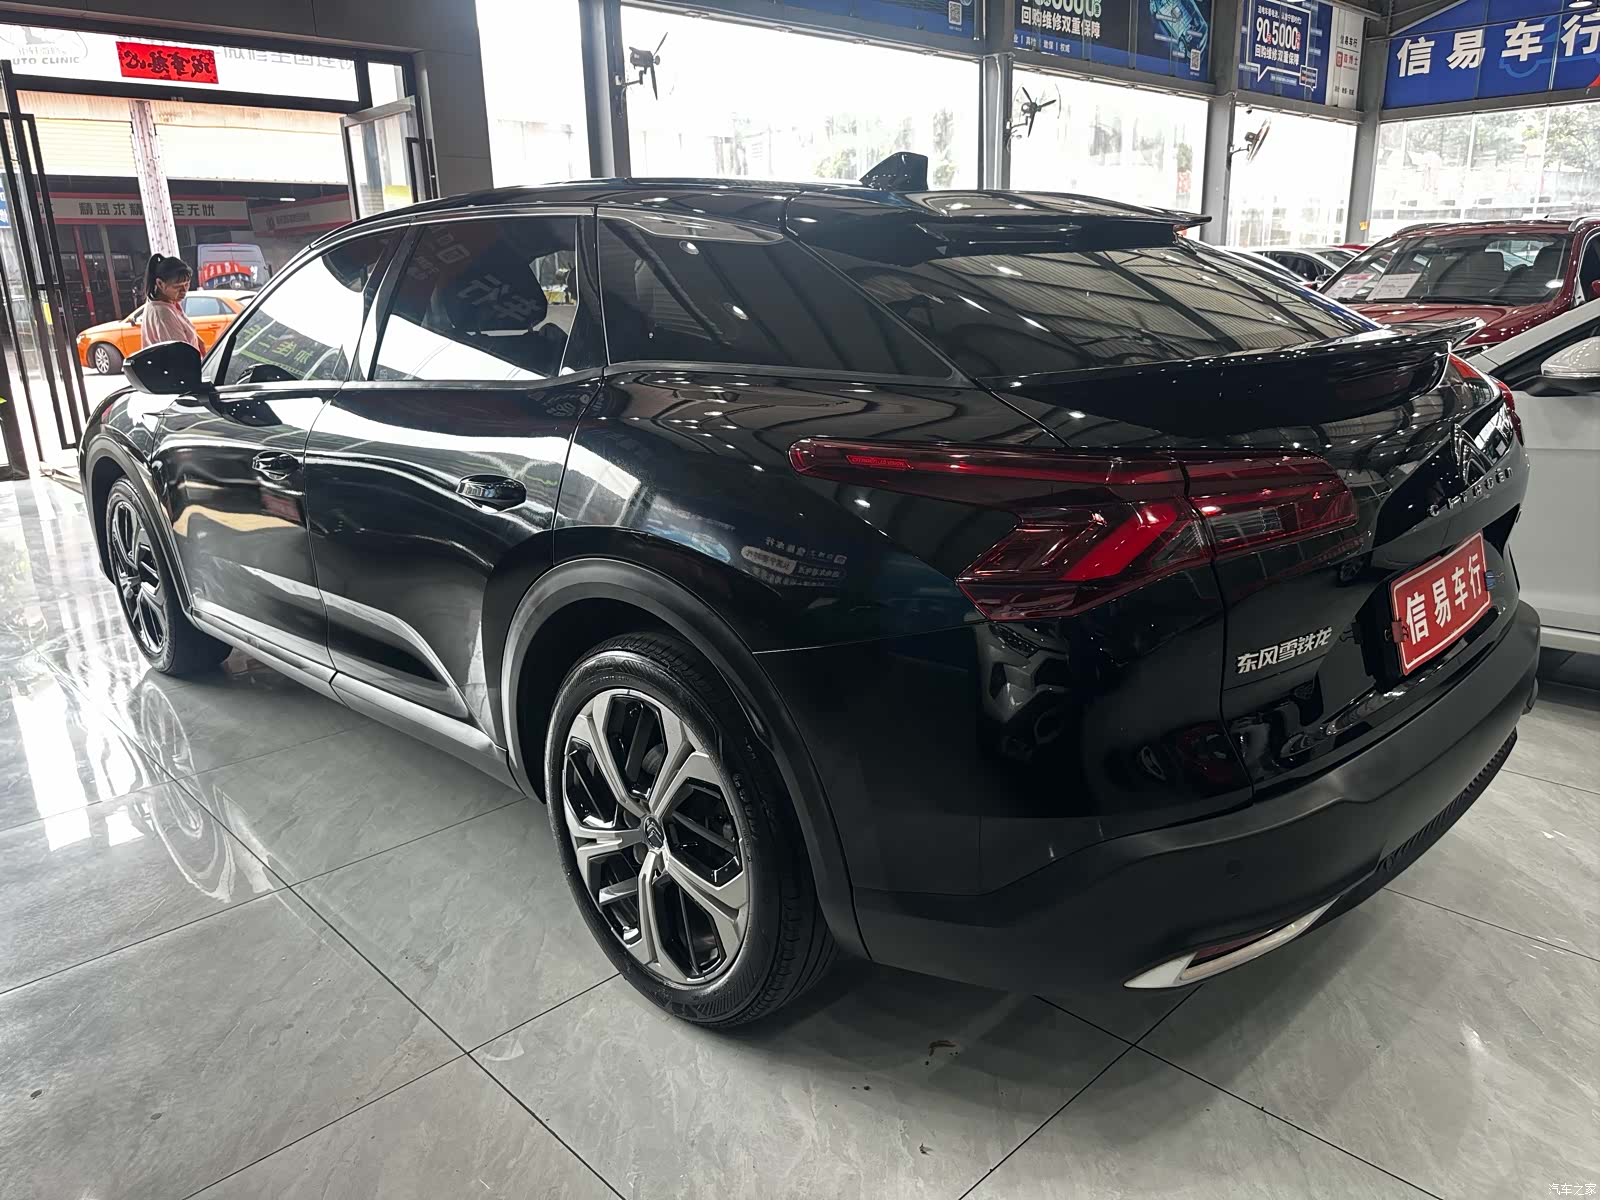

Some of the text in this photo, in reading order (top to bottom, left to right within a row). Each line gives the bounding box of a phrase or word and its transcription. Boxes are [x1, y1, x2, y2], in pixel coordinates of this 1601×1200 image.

[1021, 5, 1101, 39] 回购维修双重保障
[41, 56, 80, 65] CLINIC
[1254, 43, 1300, 66] 回购维修双重保障
[1396, 14, 1601, 78] 信易车行
[1404, 554, 1484, 647] 信易车行
[1237, 626, 1333, 674] 东风雪铁龙
